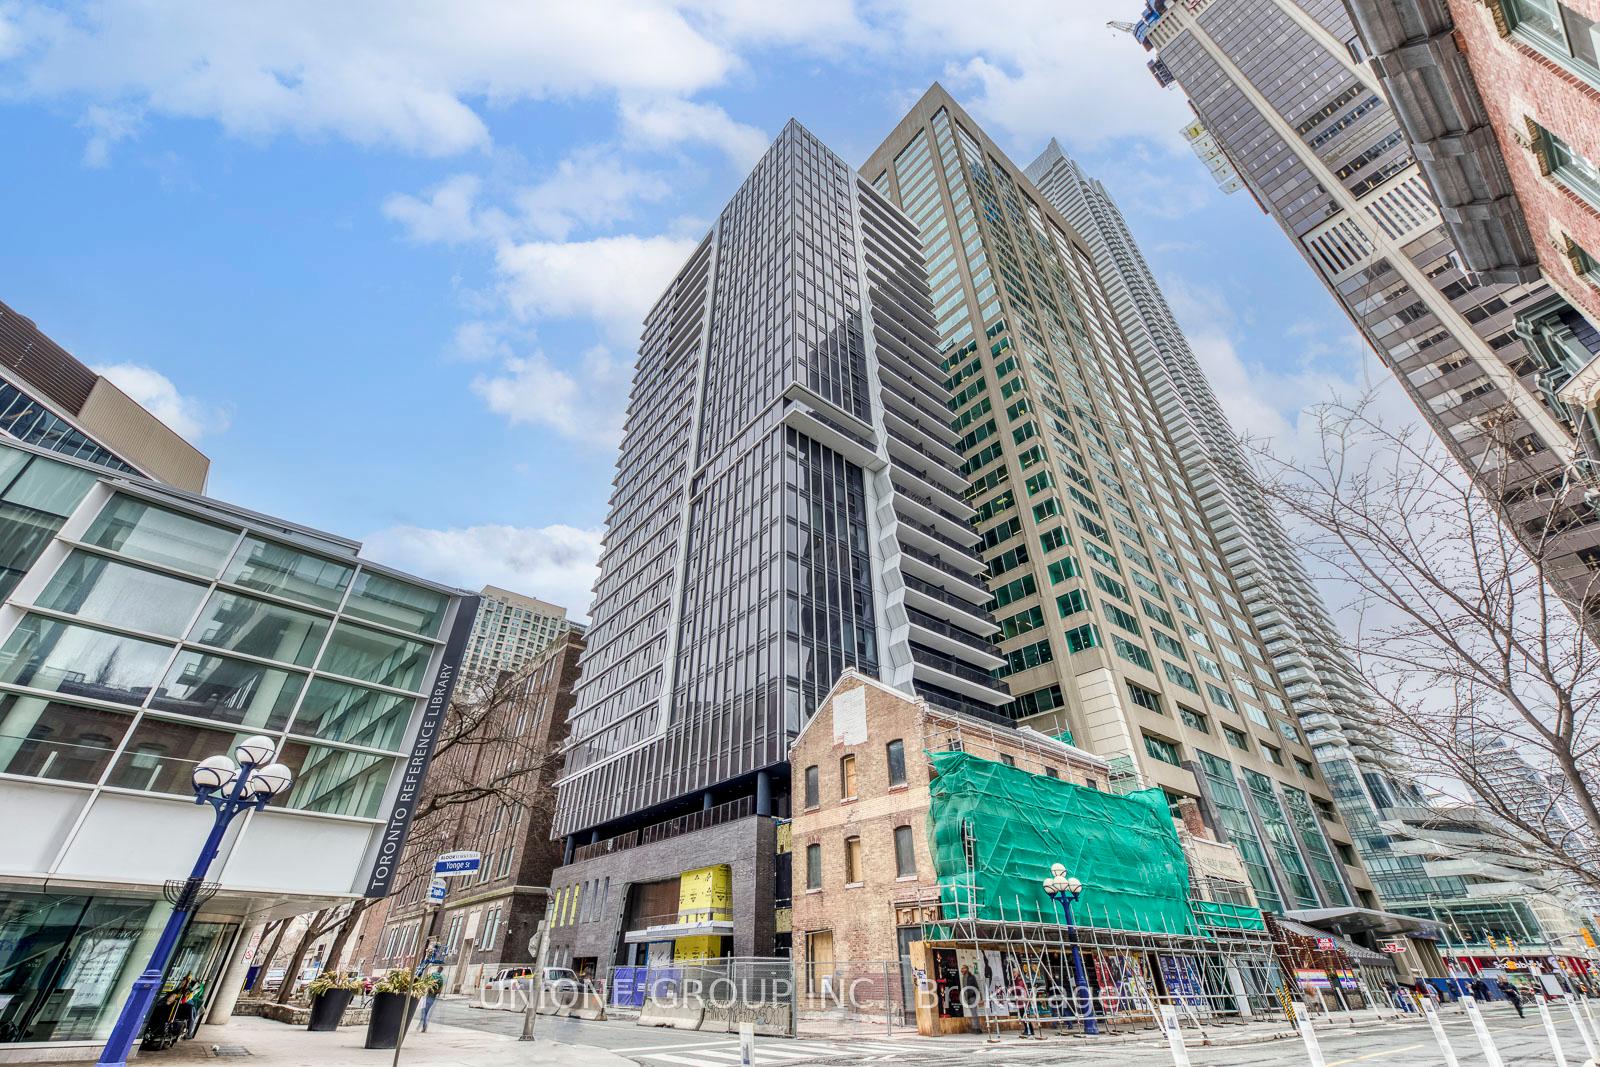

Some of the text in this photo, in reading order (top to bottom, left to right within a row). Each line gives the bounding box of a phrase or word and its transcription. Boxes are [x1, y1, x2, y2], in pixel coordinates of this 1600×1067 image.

[371, 663, 453, 890] TORONTO REFERENCE LIBRARY
[446, 861, 465, 870] Yonge
